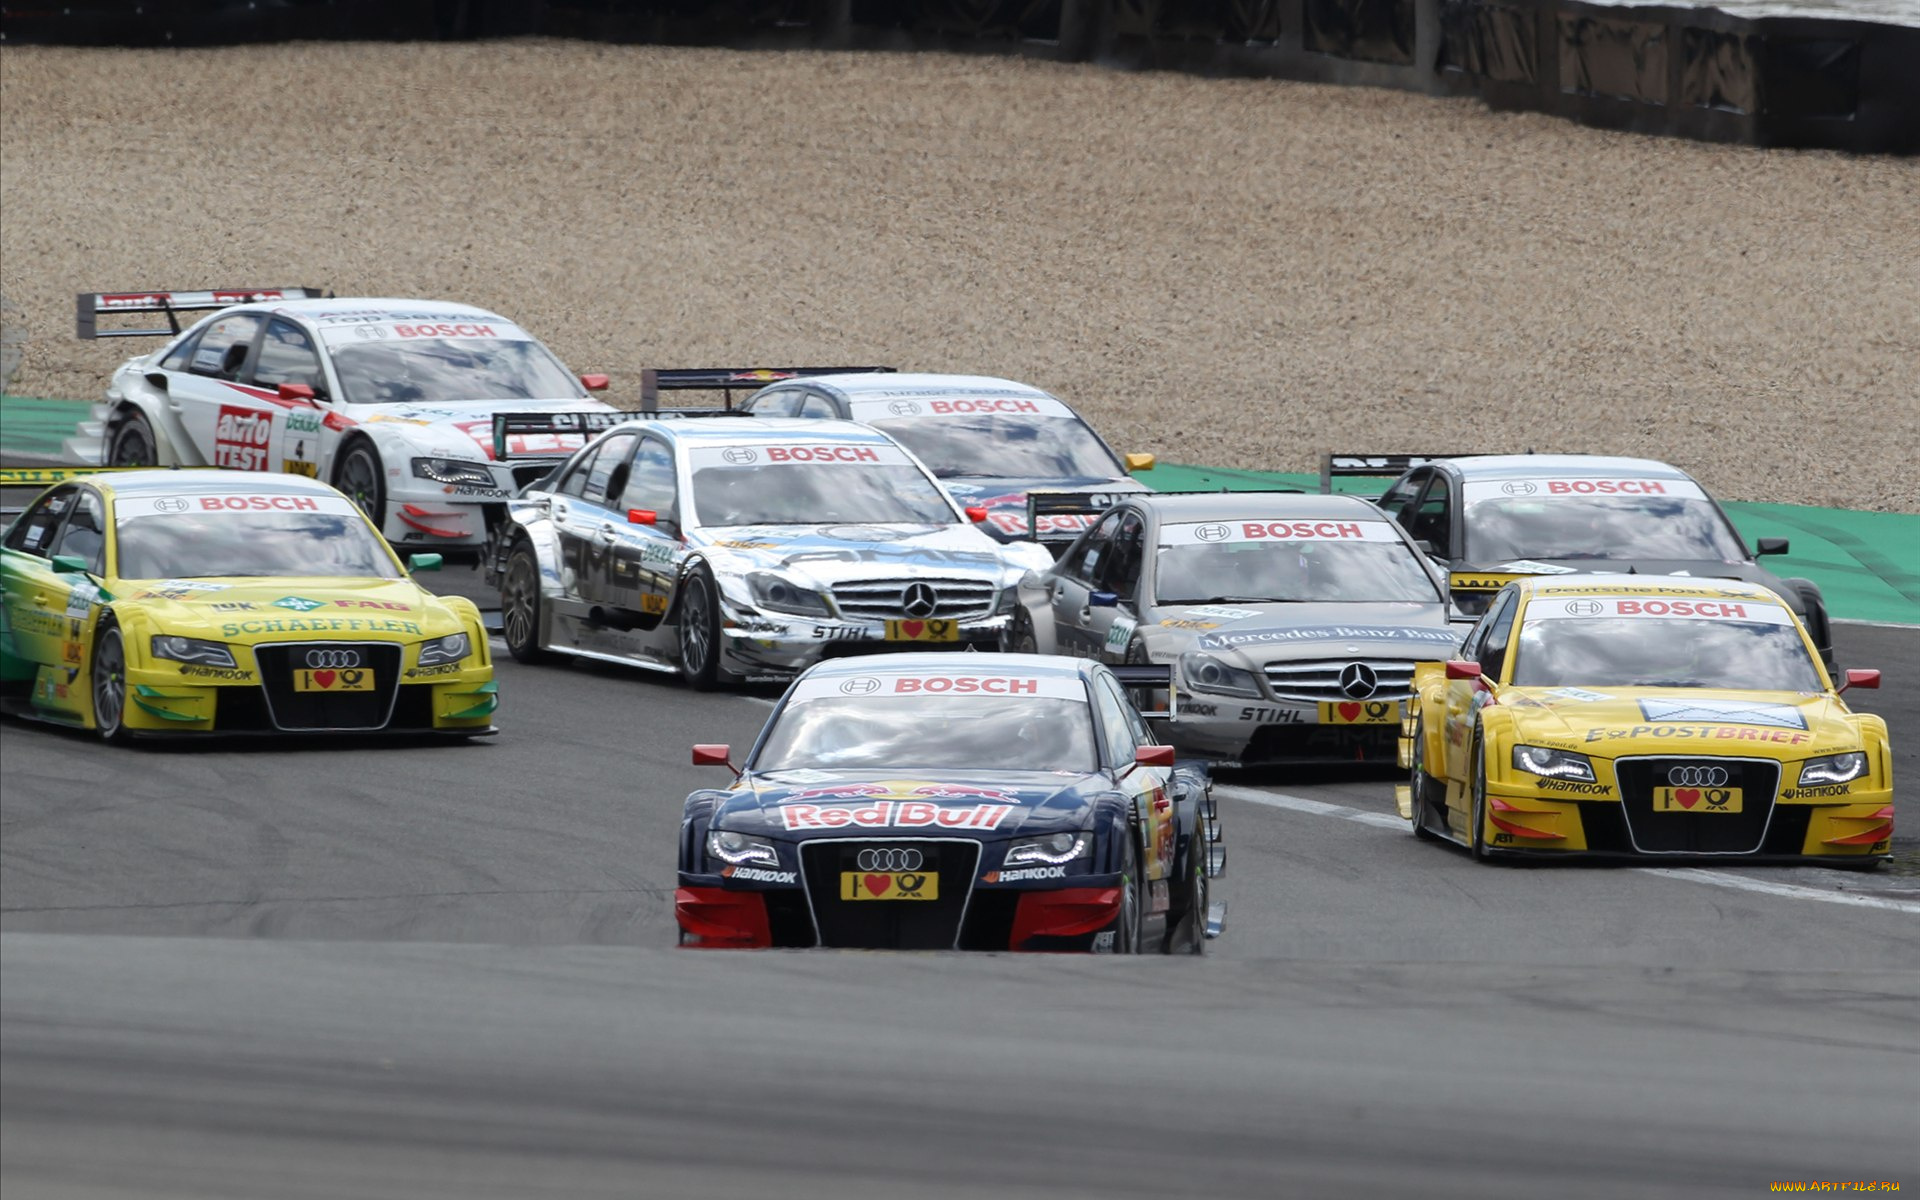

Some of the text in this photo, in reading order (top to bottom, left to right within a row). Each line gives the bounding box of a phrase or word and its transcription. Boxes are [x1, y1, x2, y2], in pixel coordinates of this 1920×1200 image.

[394, 324, 497, 337] BOSCH
[930, 399, 1040, 414] BOSCH
[217, 411, 270, 445] auto
[295, 439, 304, 460] 4
[767, 447, 879, 462] BOSCH
[216, 444, 267, 471] TEST
[1547, 480, 1666, 494] BOSCH
[199, 497, 318, 511] BOSCH
[1242, 523, 1363, 538] BOSCH
[1545, 587, 1707, 595] Deutsche Post
[334, 600, 411, 612] FAG
[1616, 601, 1748, 618] BOSCH
[222, 619, 424, 637] SCHAEFFLER
[812, 626, 874, 640] STIHL
[1204, 627, 1399, 648] Mercedes-Benz
[895, 677, 1038, 694] BOSCH
[1239, 707, 1305, 723] STIHL
[783, 801, 1013, 830] Red Bull
